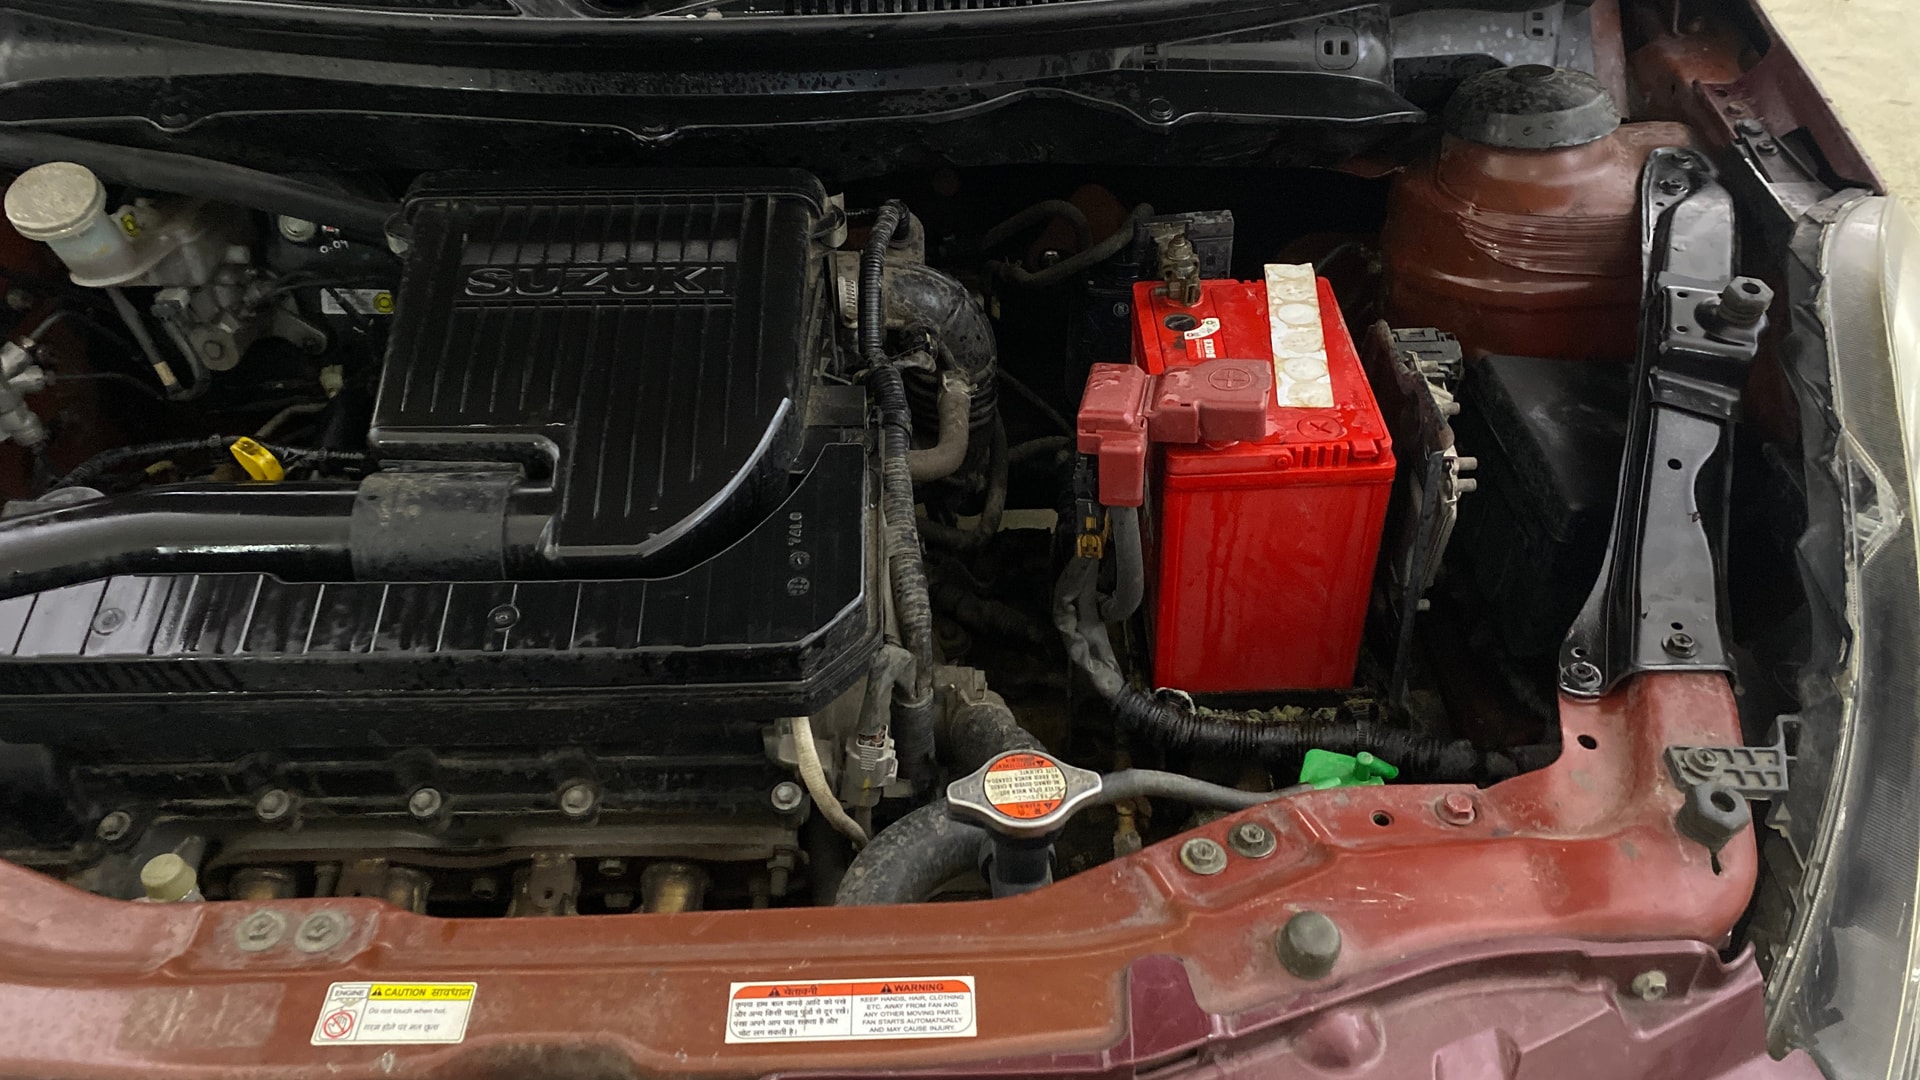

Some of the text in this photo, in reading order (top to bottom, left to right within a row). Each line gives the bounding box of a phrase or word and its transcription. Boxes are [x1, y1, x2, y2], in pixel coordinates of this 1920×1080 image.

[464, 267, 725, 297] SUZUKI
[894, 983, 944, 991] WARNING
[384, 988, 427, 996] CAUTION
[432, 988, 471, 997] सावधान
